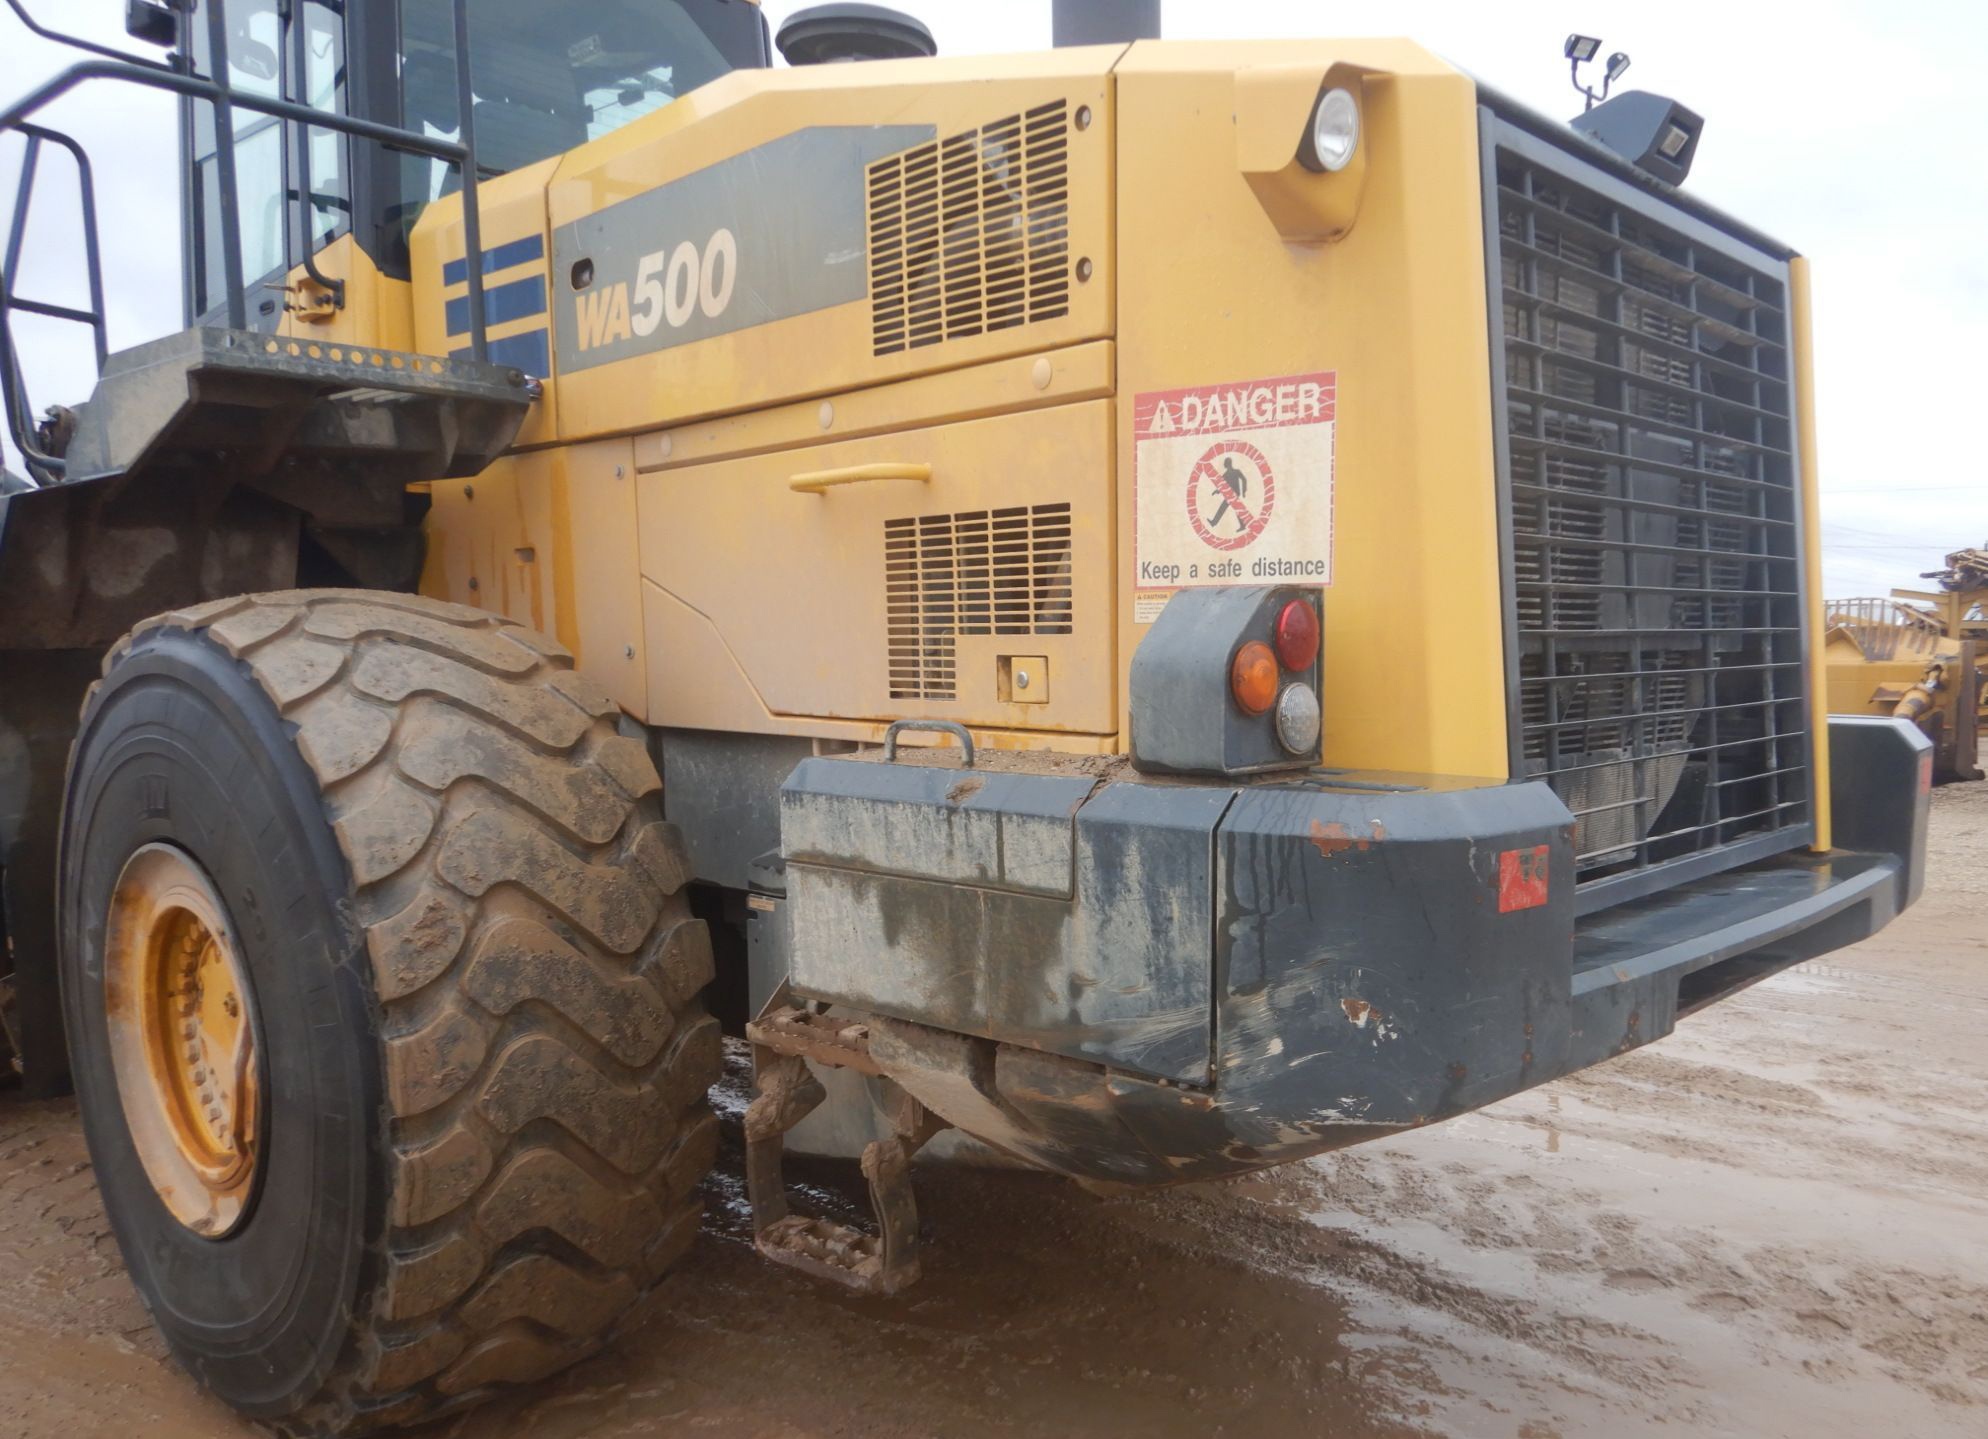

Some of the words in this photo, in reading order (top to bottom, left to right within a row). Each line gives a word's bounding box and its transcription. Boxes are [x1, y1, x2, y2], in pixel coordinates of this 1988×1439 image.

[576, 228, 737, 351] WA500
[1181, 382, 1322, 431] DANGER
[1141, 561, 1180, 583] Keep
[1189, 564, 1198, 578] a
[1208, 558, 1242, 577] safe
[1252, 557, 1325, 577] distance
